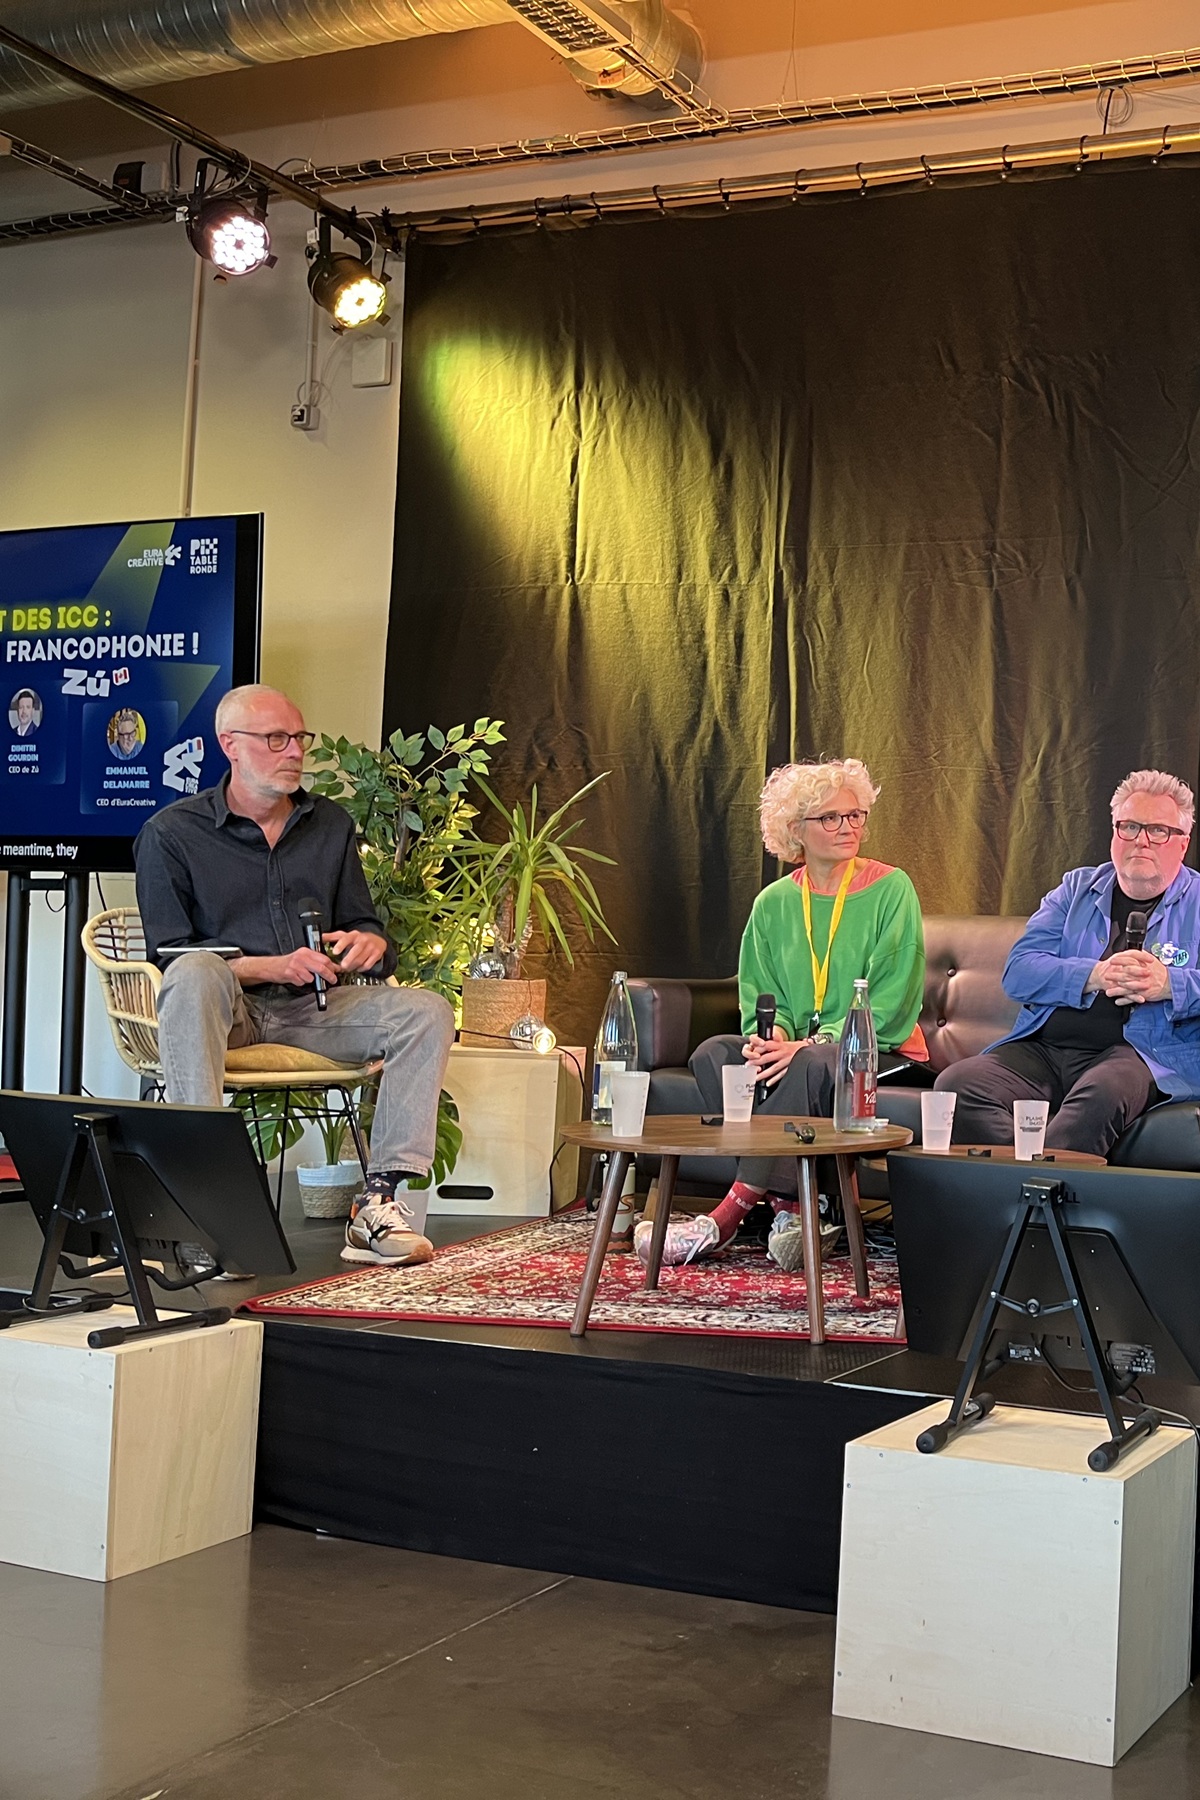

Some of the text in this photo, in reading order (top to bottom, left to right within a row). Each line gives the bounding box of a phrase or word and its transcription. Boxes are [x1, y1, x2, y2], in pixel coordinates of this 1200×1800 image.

[143, 549, 163, 558] EURA
[127, 558, 163, 568] CREATIVE
[190, 555, 218, 565] TABLE
[189, 565, 218, 574] RONDE
[12, 607, 52, 631] DES
[57, 605, 98, 629] ICC
[6, 633, 185, 663] FRANCOPHONIE
[11, 744, 36, 752] DIMITRI
[8, 754, 38, 762] GOURDIN
[105, 766, 148, 775] EMMANUEL
[103, 780, 150, 789] DELAMARRE
[3, 843, 54, 858] meantime,
[56, 843, 78, 860] they
